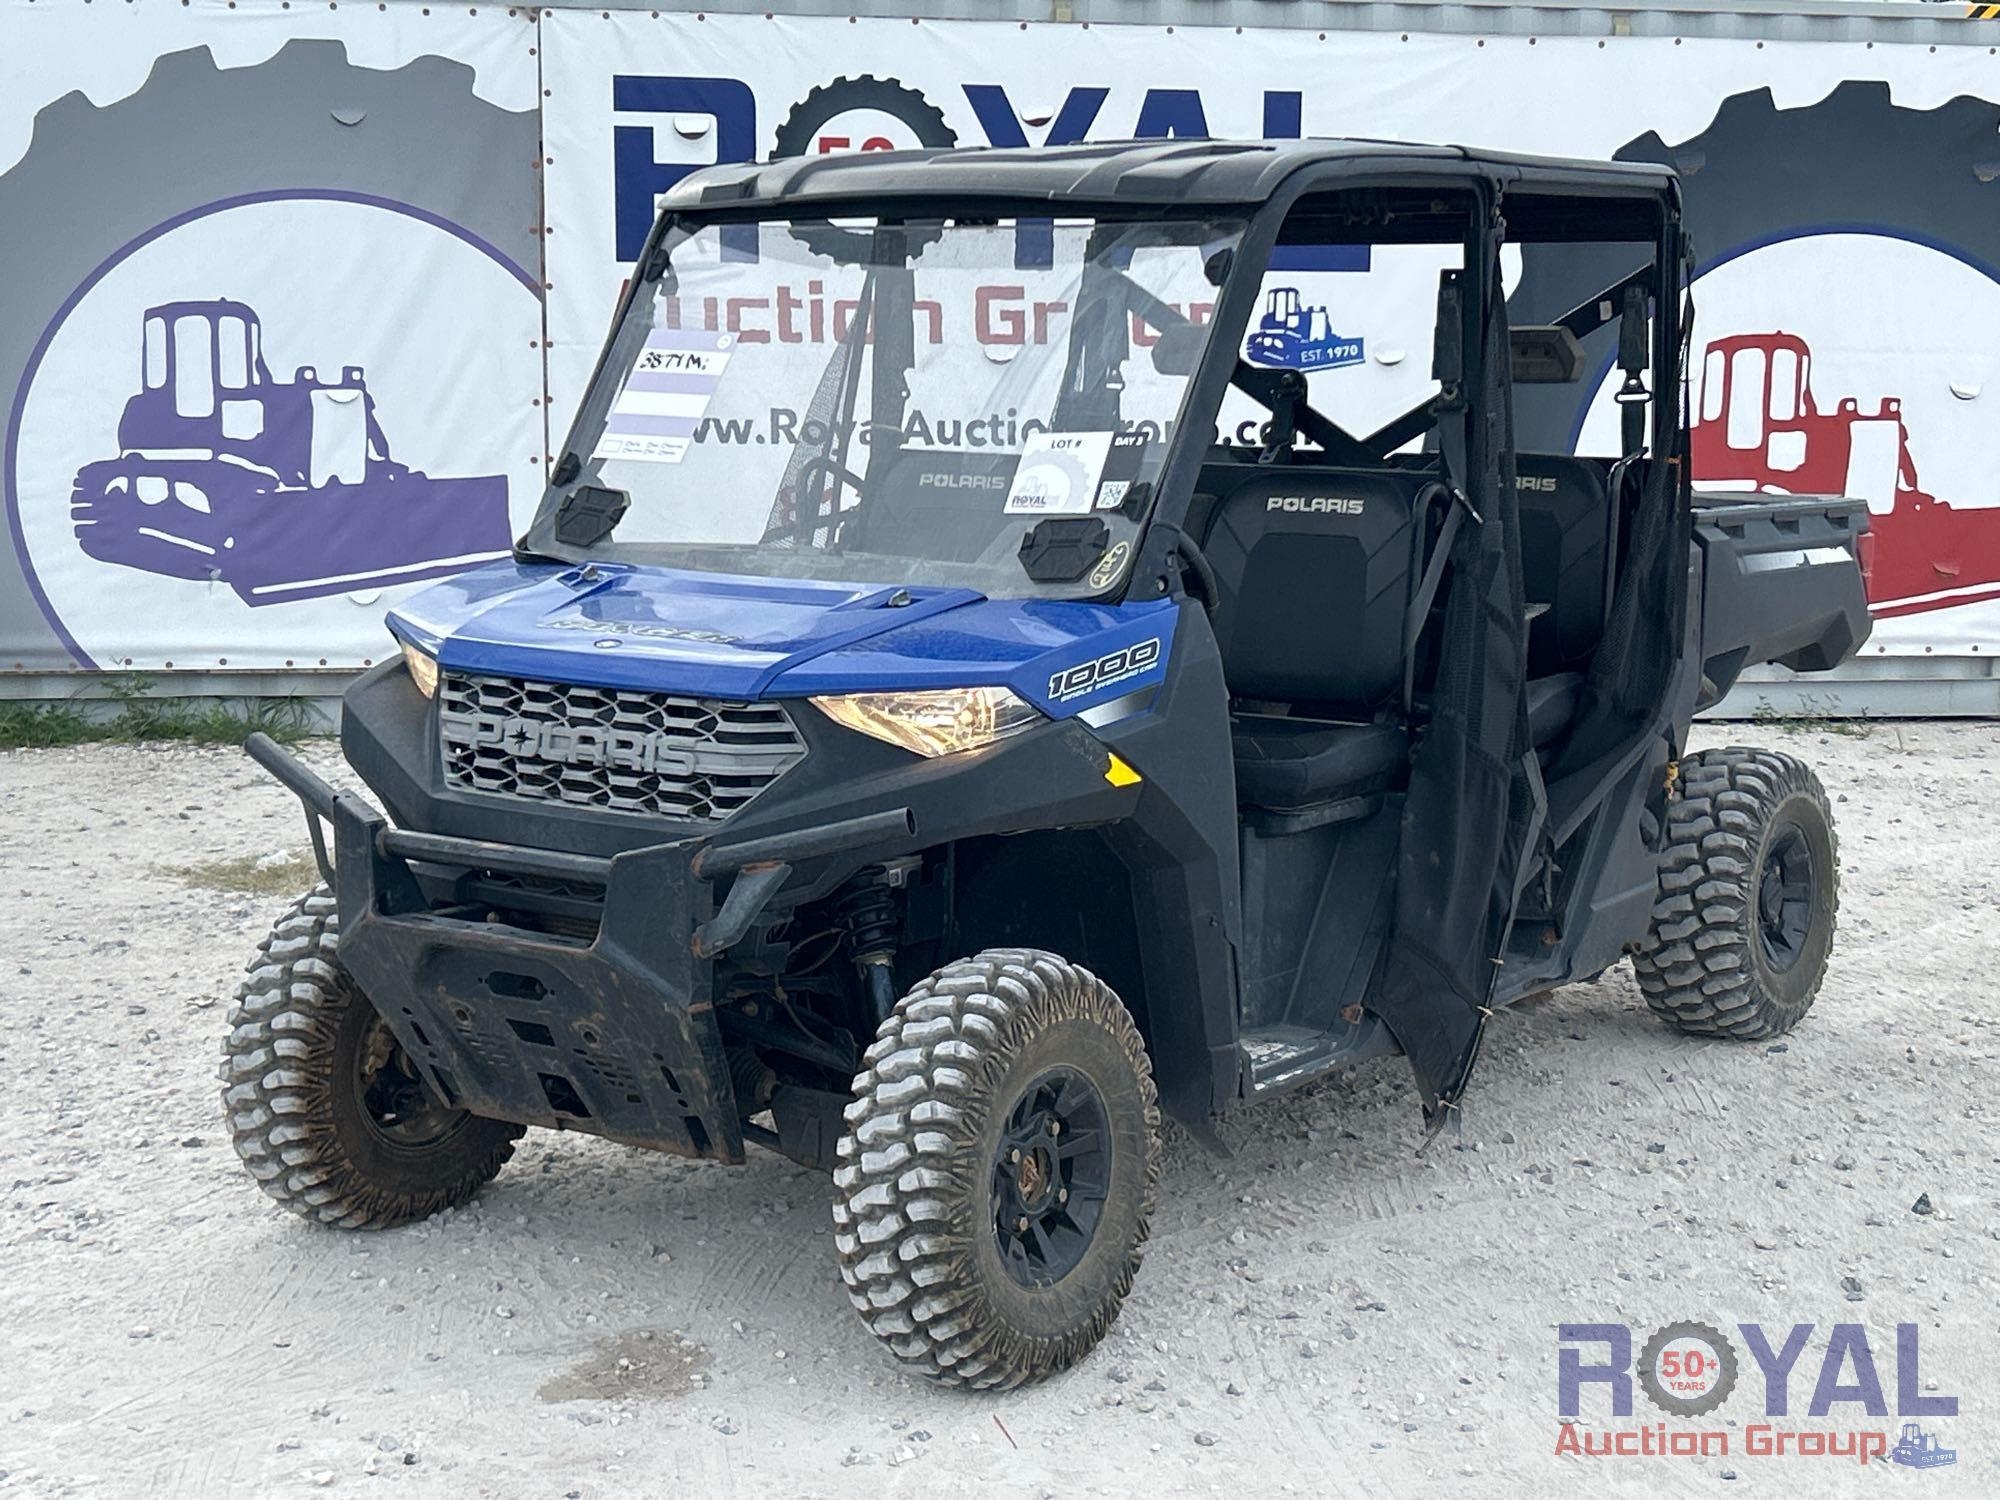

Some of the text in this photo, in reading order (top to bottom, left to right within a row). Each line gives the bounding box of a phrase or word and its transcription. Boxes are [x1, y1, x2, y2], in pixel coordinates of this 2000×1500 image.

[614, 279, 943, 344] uction
[1300, 344, 1359, 363] EST. 1970
[1050, 439, 1073, 449] LOT
[1114, 436, 1136, 447] DAY
[919, 473, 1005, 489] POLARIS
[1266, 496, 1364, 515] POLARIS
[1047, 637, 1161, 700] 1000
[470, 713, 698, 777] POLARIS
